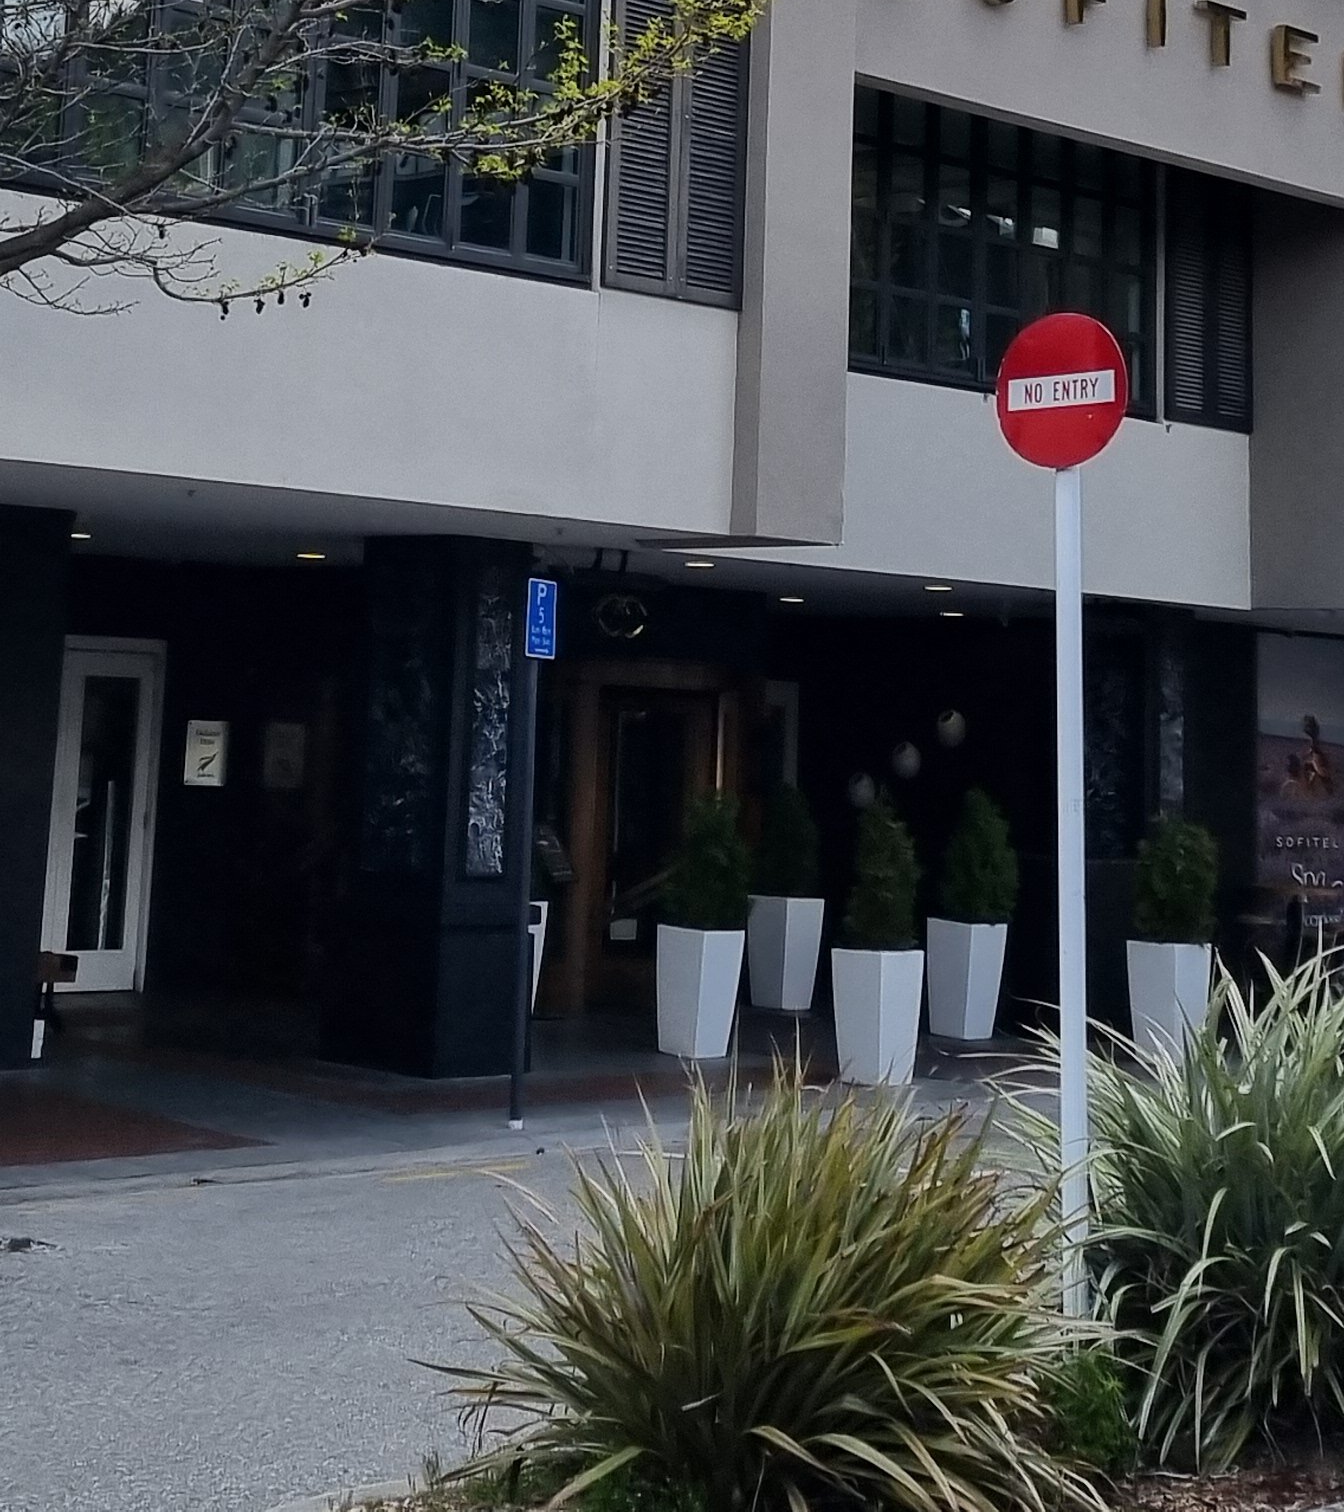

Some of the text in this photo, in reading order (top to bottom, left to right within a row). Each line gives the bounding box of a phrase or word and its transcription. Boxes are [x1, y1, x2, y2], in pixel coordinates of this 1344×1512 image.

[1024, 377, 1099, 404] NO ENTRY
[537, 583, 548, 606] P
[1276, 836, 1339, 849] SOFITEL
